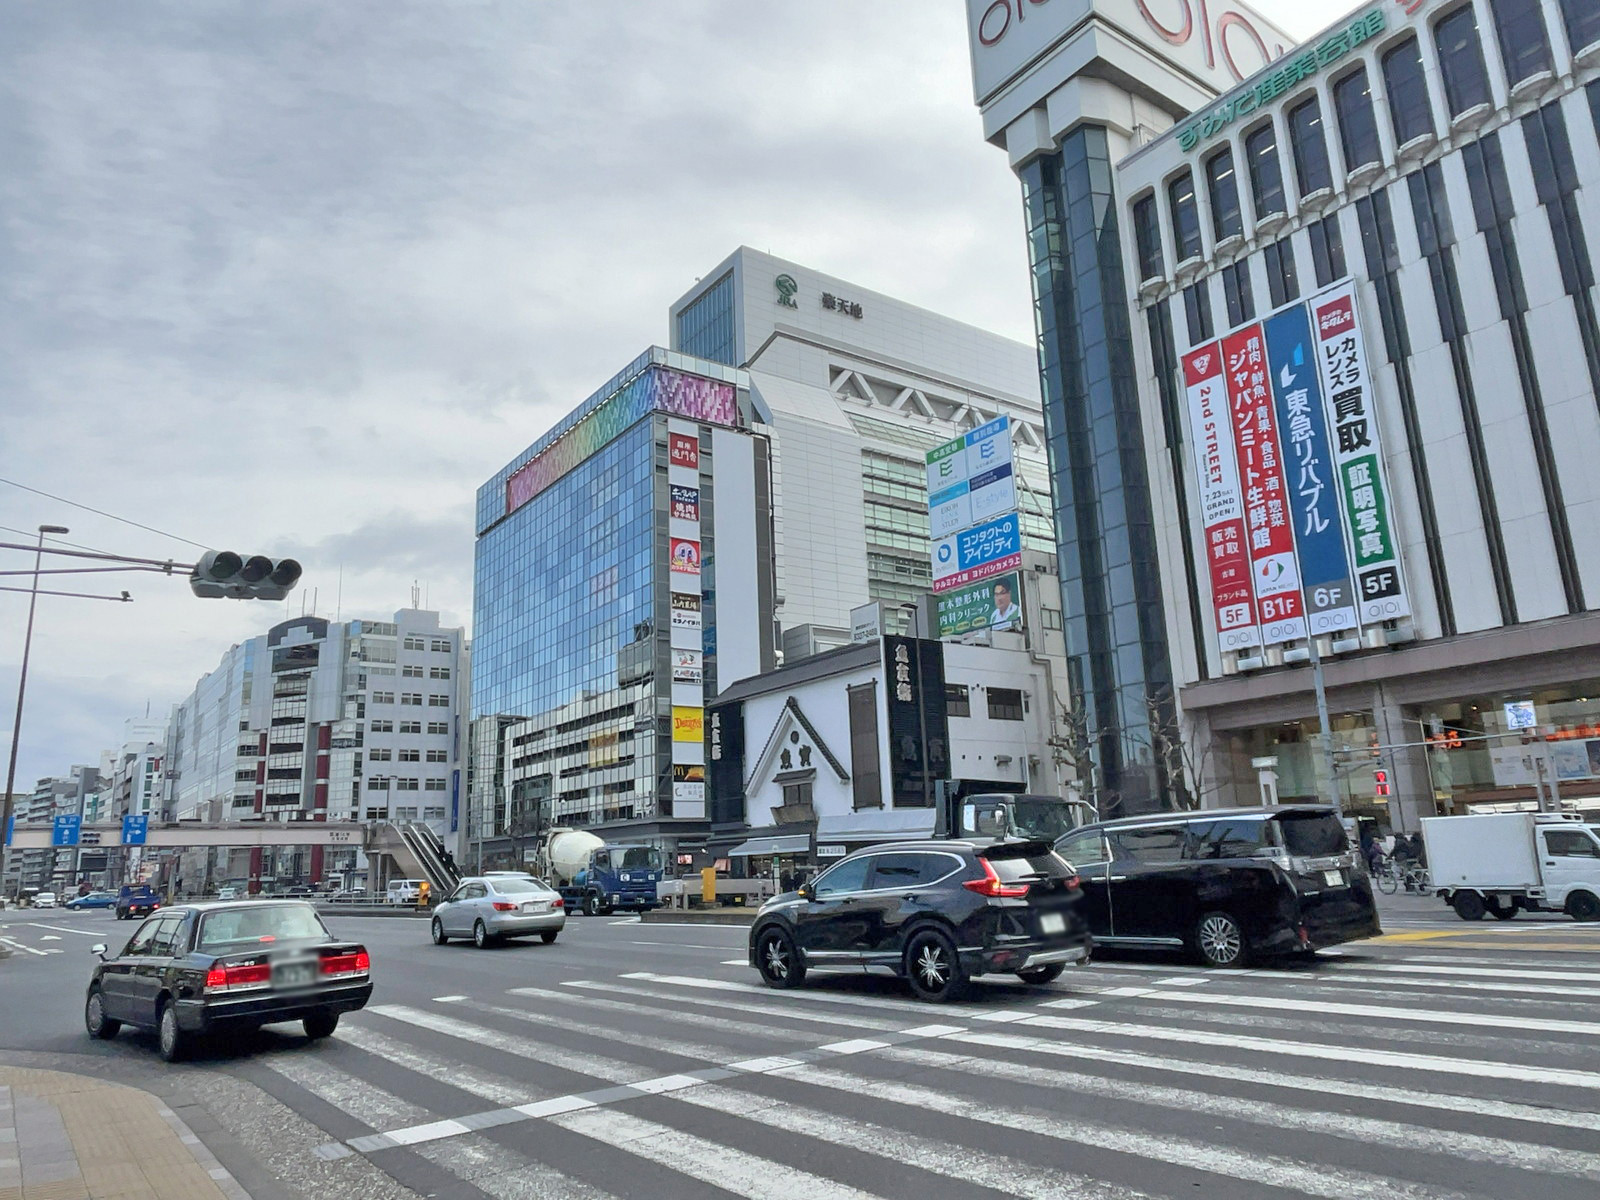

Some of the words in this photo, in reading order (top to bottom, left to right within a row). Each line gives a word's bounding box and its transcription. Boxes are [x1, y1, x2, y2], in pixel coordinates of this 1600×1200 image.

[776, 294, 799, 309] JRA
[1325, 345, 1344, 390] レンズ
[1341, 337, 1360, 384] カメラ
[1200, 385, 1214, 419] 2nd
[1332, 385, 1372, 454] 買取
[1204, 421, 1223, 484] STREET
[1229, 353, 1272, 550] ジャパンミート生鮮館
[1285, 387, 1330, 536] 東急リバブル
[1206, 497, 1235, 511] GRAND
[1347, 459, 1385, 559] 証明写真
[962, 521, 1013, 549] コンタクトの
[1211, 526, 1237, 545] 販売
[963, 537, 1013, 564] アイシティ
[1213, 541, 1240, 560] 買取
[1217, 588, 1249, 602] ブランド品
[1365, 573, 1392, 594] 5F
[1263, 597, 1295, 619] B1F
[1314, 588, 1342, 608] 6F
[939, 603, 990, 626] 内科クリニック
[1225, 608, 1243, 624] 5F
[674, 717, 703, 730] Denny's
